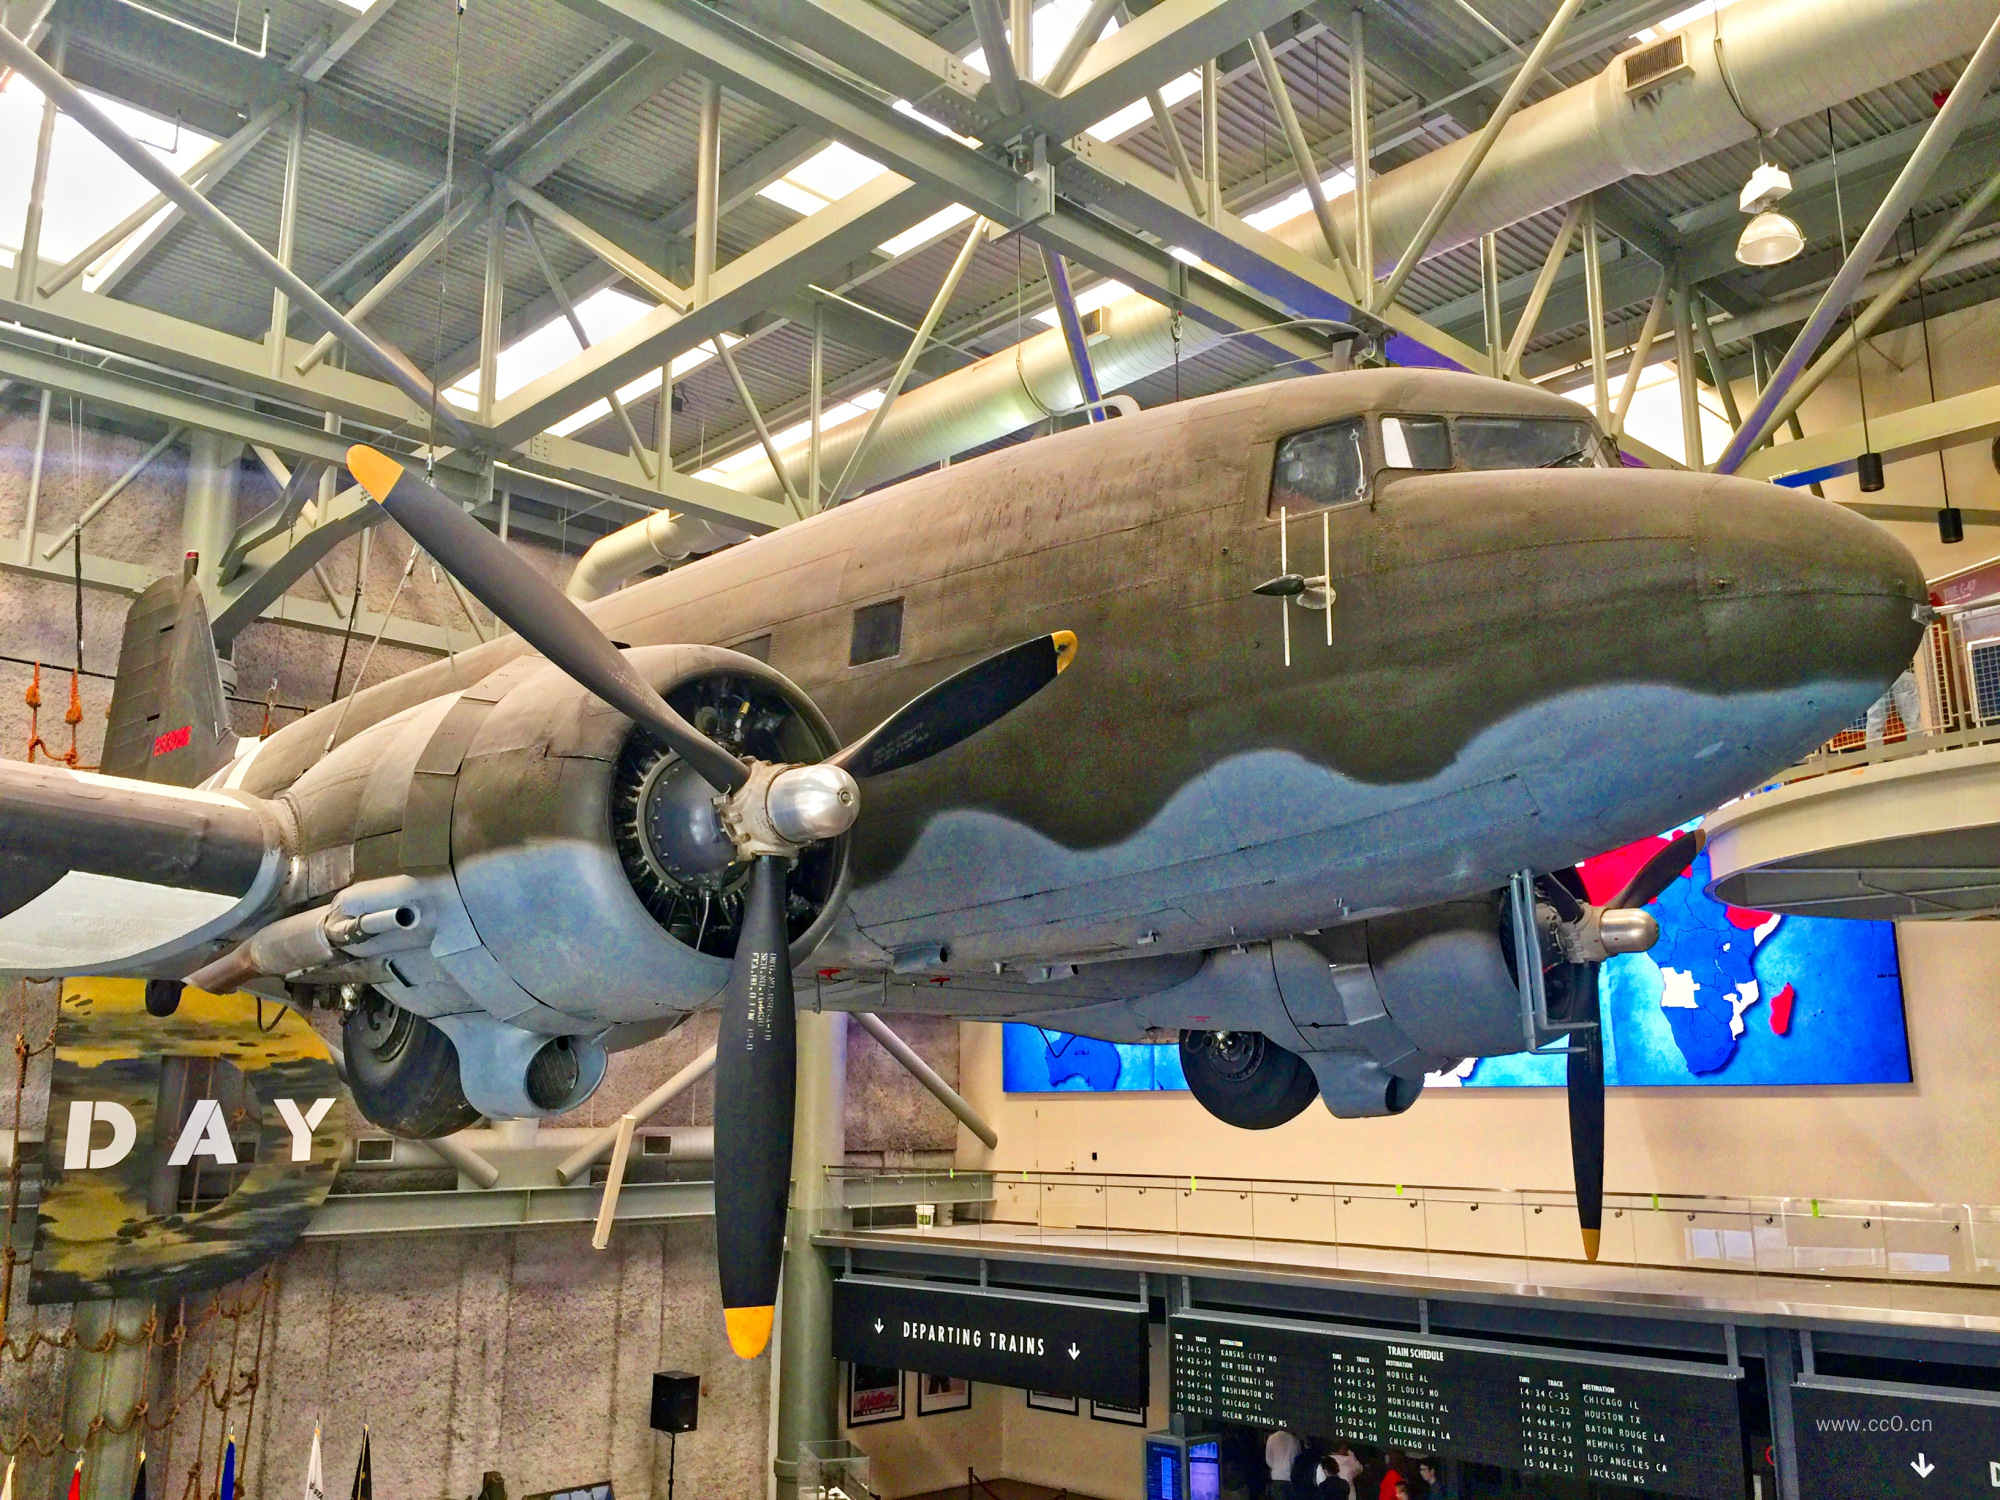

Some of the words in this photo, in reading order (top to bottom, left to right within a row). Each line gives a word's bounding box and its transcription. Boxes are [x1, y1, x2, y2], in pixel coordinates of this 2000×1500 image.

[903, 1321, 981, 1347] DEPARTING
[990, 1332, 1045, 1356] TRAINS
[1387, 1346, 1409, 1357] TRAIN
[1410, 1348, 1444, 1361] SCHEDULE
